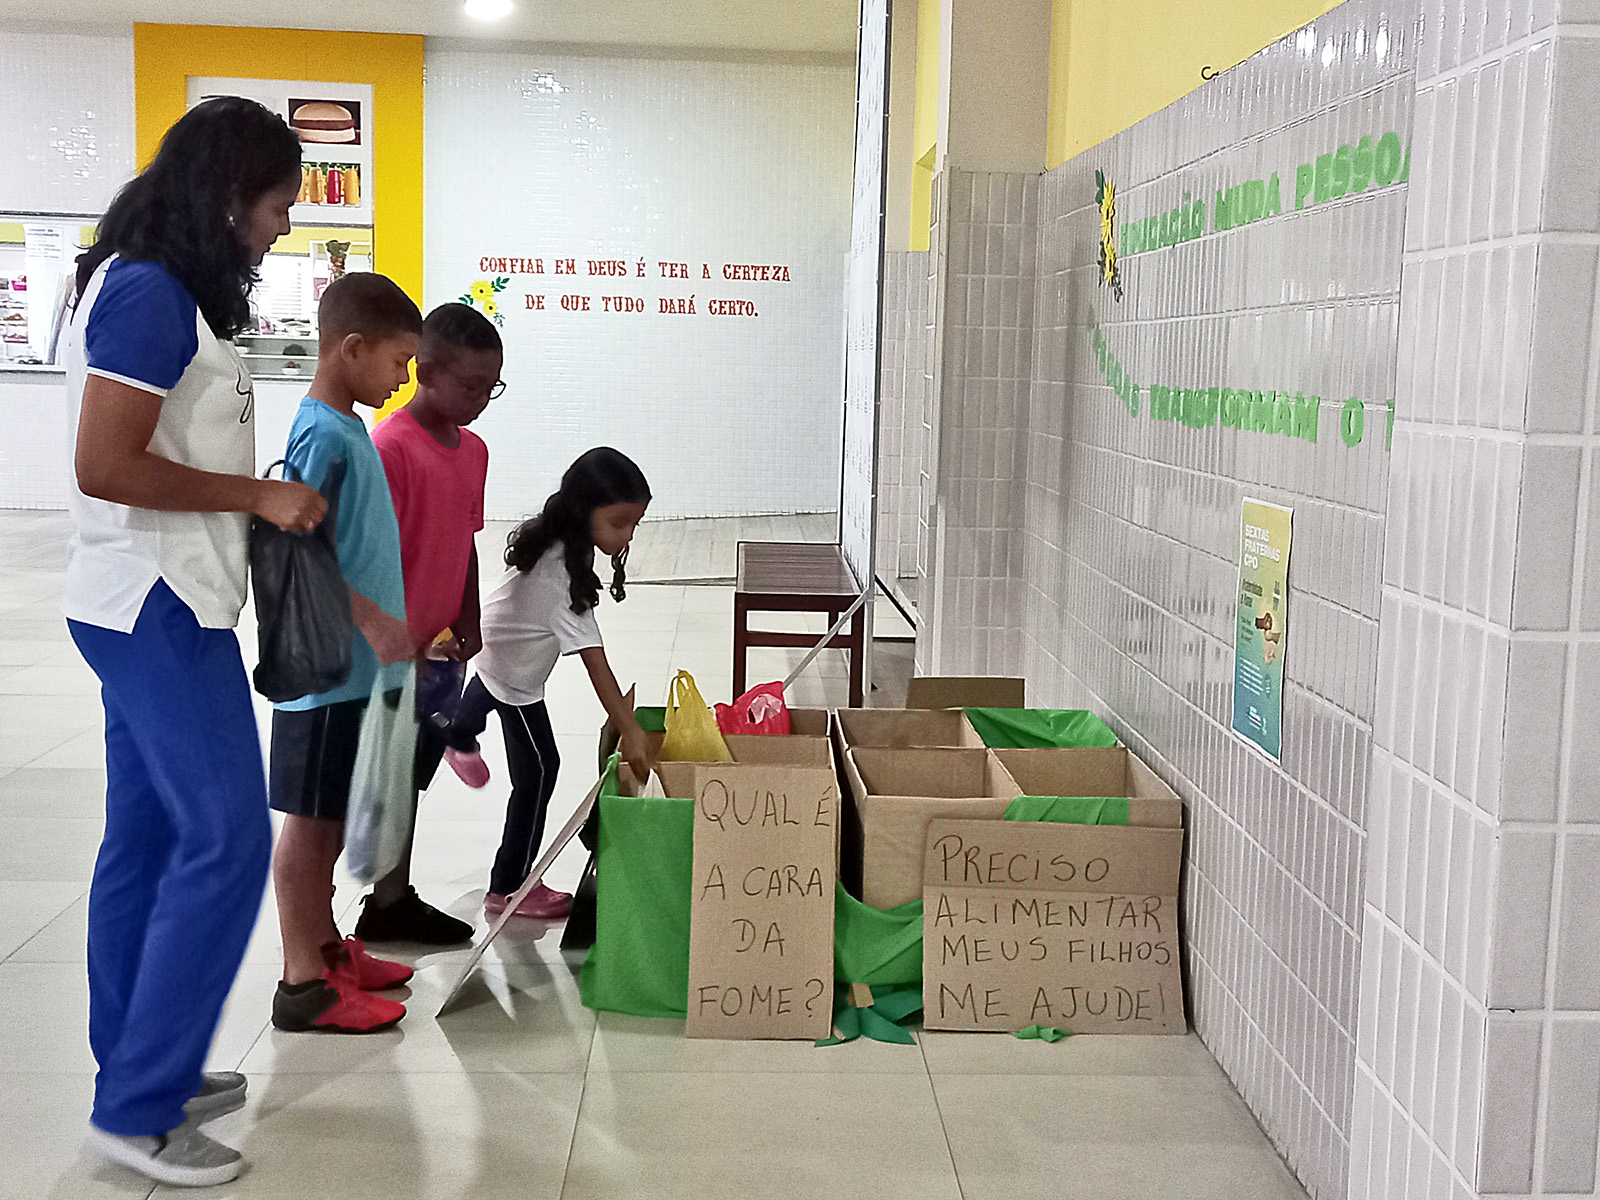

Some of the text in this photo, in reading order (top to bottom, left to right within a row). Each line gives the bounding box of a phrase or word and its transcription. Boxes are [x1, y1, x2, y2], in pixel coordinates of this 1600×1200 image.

[1212, 171, 1283, 231] MUDA
[479, 256, 792, 283] CONFIAR EM DEUS É TER A CERTEZA
[525, 294, 760, 317] DE QUE TUDO DARÁ CERTO.
[1340, 397, 1365, 448] O
[1245, 524, 1270, 543] SEXTAS
[701, 778, 832, 832] QUAL É
[700, 863, 824, 902] A CARA
[731, 917, 786, 957] DA
[941, 934, 1171, 967] MEUS FILHOS
[698, 977, 826, 1020] FOME?
[938, 982, 1168, 1028] ME AJUDE!
